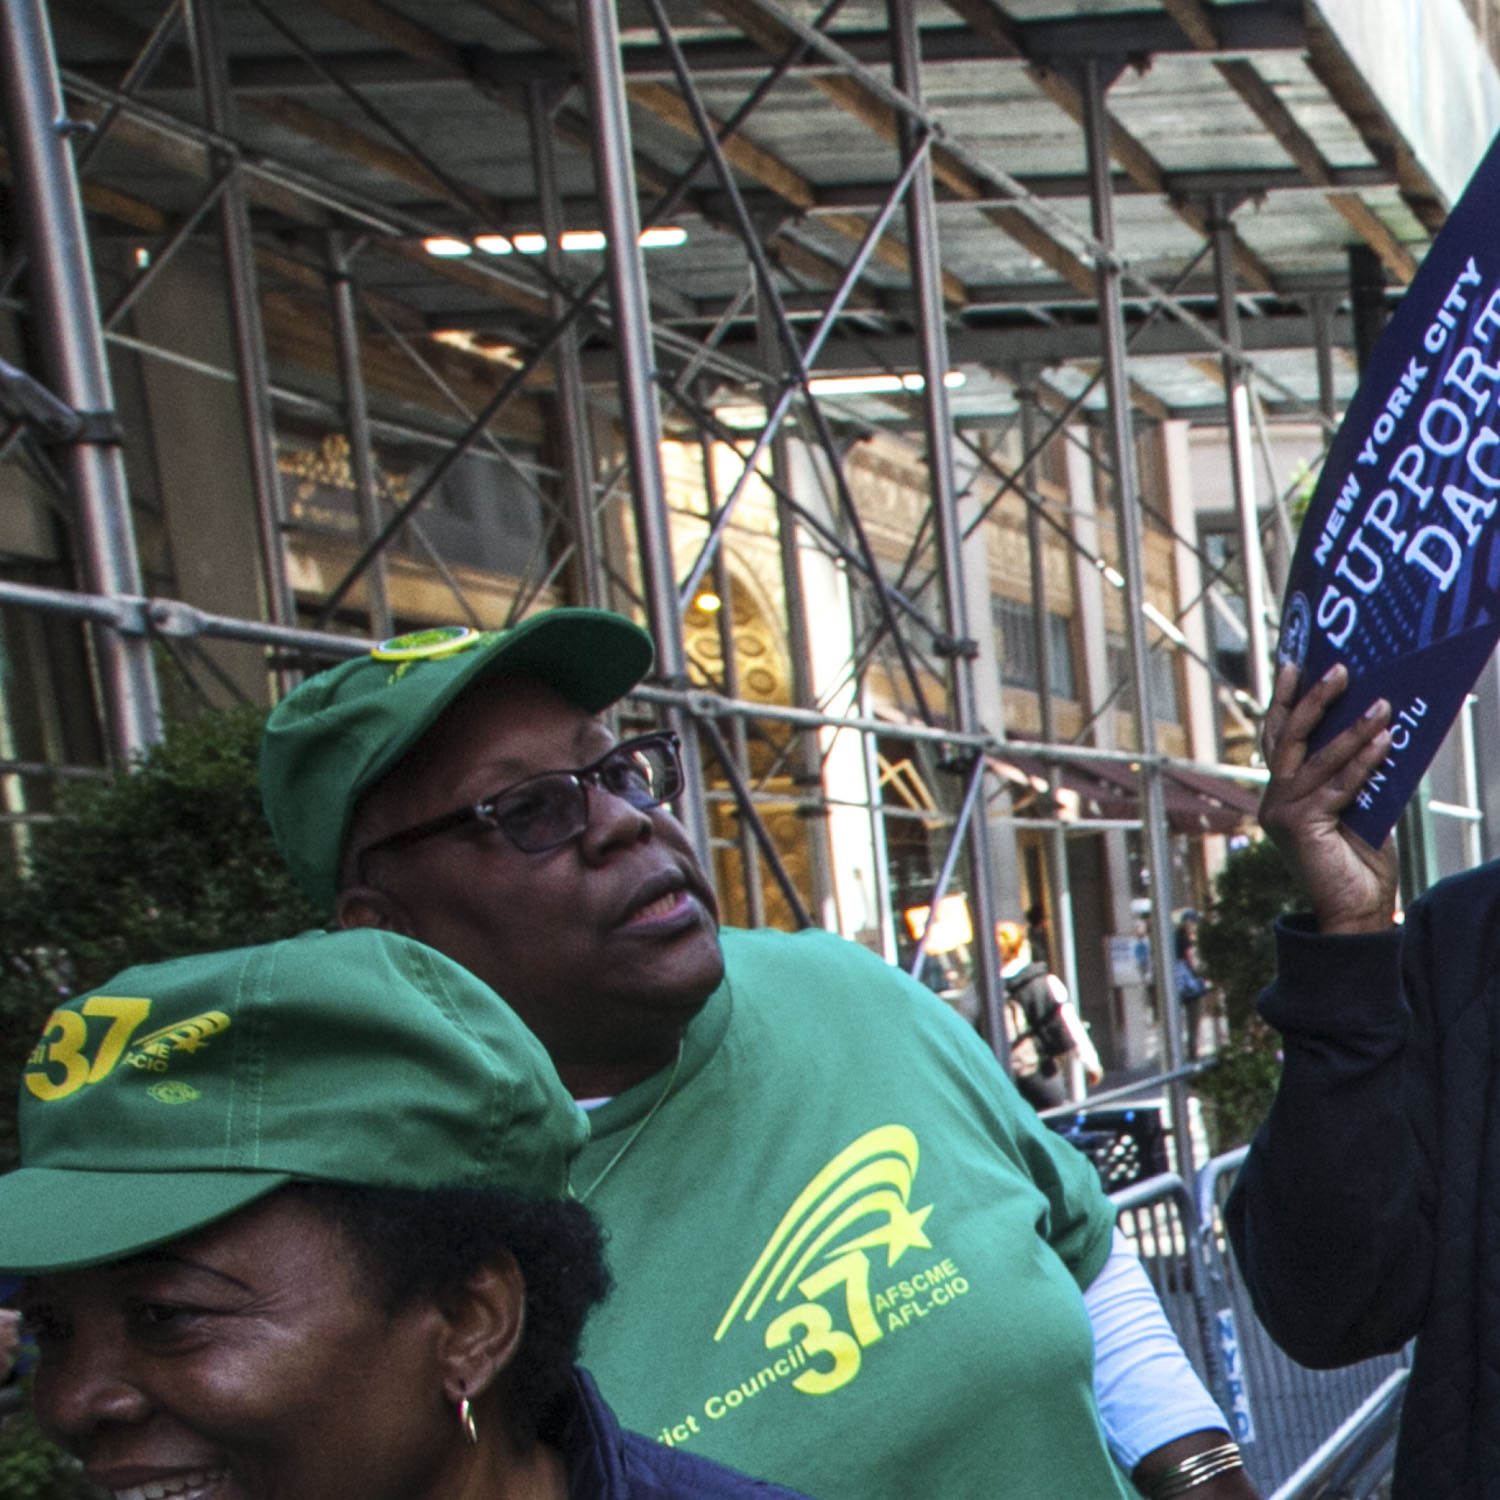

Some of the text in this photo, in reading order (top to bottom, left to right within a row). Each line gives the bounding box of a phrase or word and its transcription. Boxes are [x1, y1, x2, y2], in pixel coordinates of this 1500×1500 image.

[1314, 257, 1484, 566] NEW YORK CITY
[24, 996, 152, 1102] 37
[704, 1249, 884, 1420] Council 37
[874, 1258, 959, 1312] AFSCME
[887, 1276, 970, 1332] AFL-CIO
